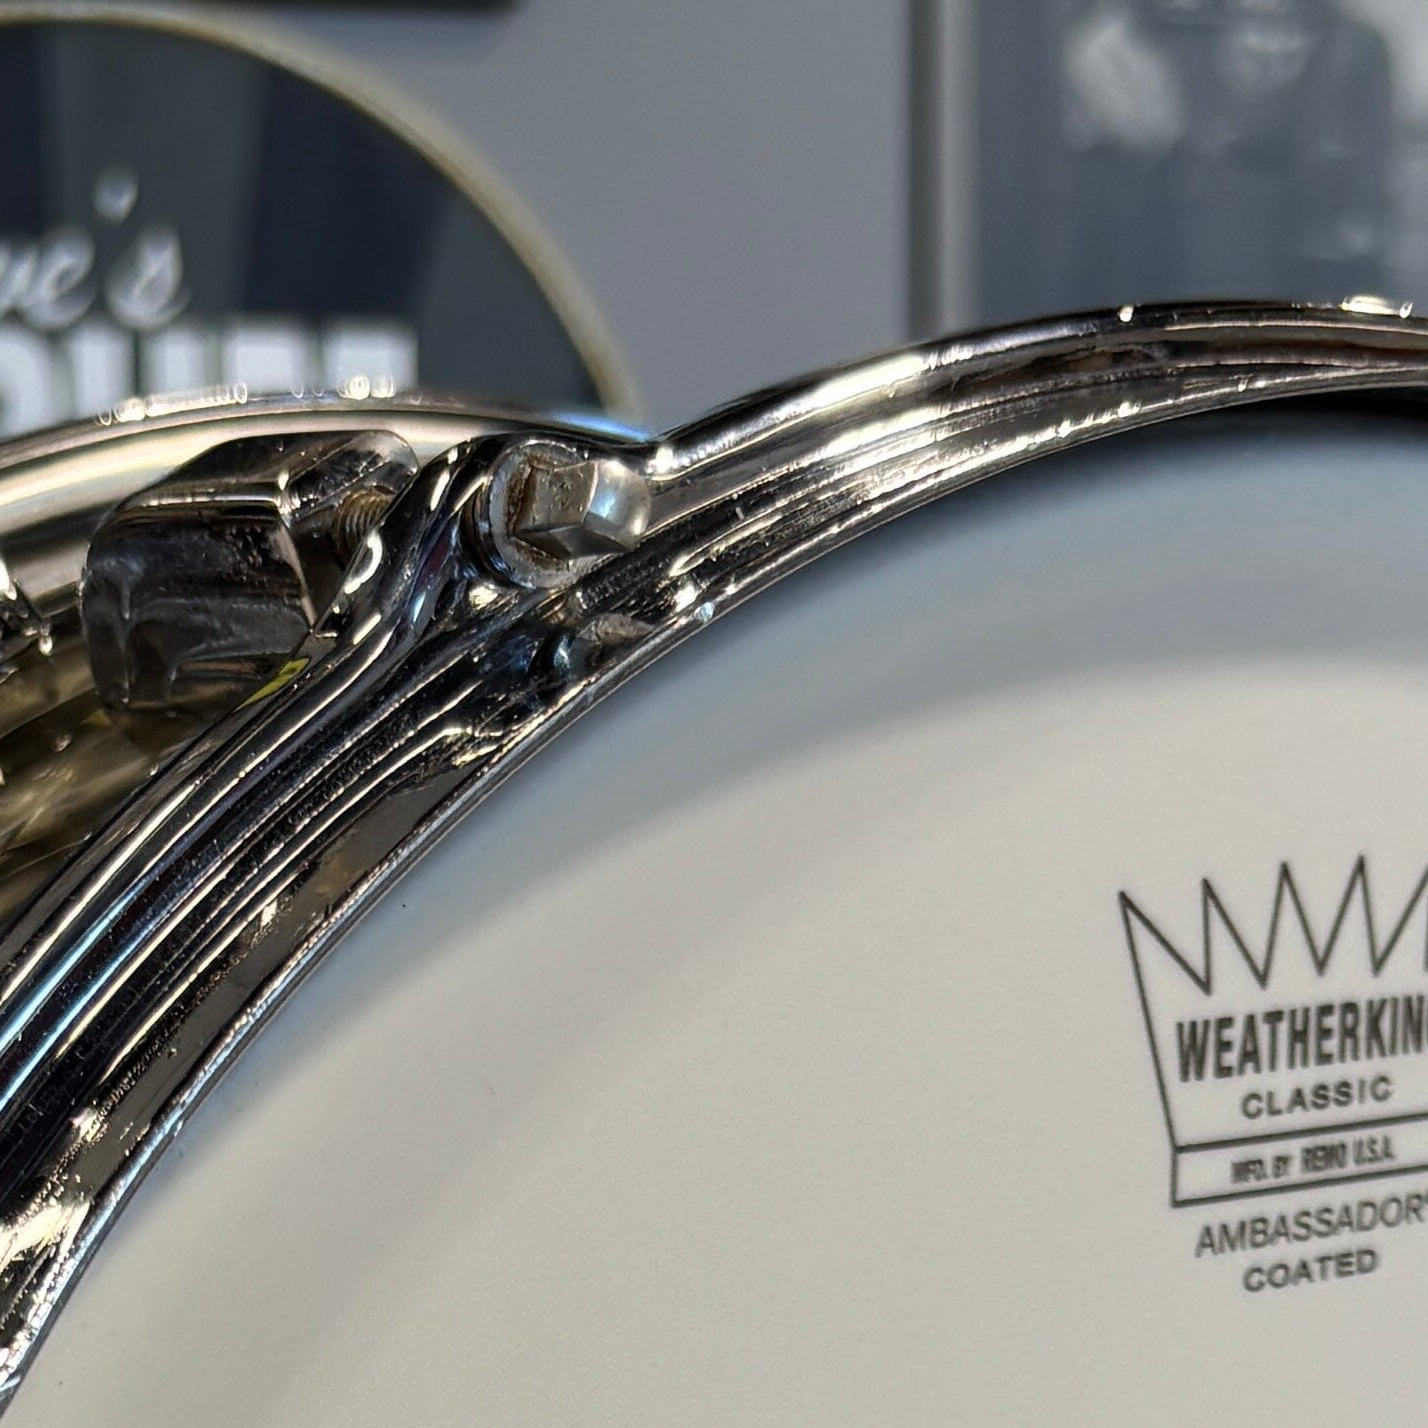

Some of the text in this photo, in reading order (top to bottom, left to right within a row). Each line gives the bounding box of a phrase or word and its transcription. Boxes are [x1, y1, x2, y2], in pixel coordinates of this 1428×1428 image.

[1241, 1075, 1393, 1120] CLASSIC
[1272, 1154, 1292, 1179] BY
[1300, 1141, 1348, 1174] REMO
[1242, 1248, 1381, 1293] COATED
